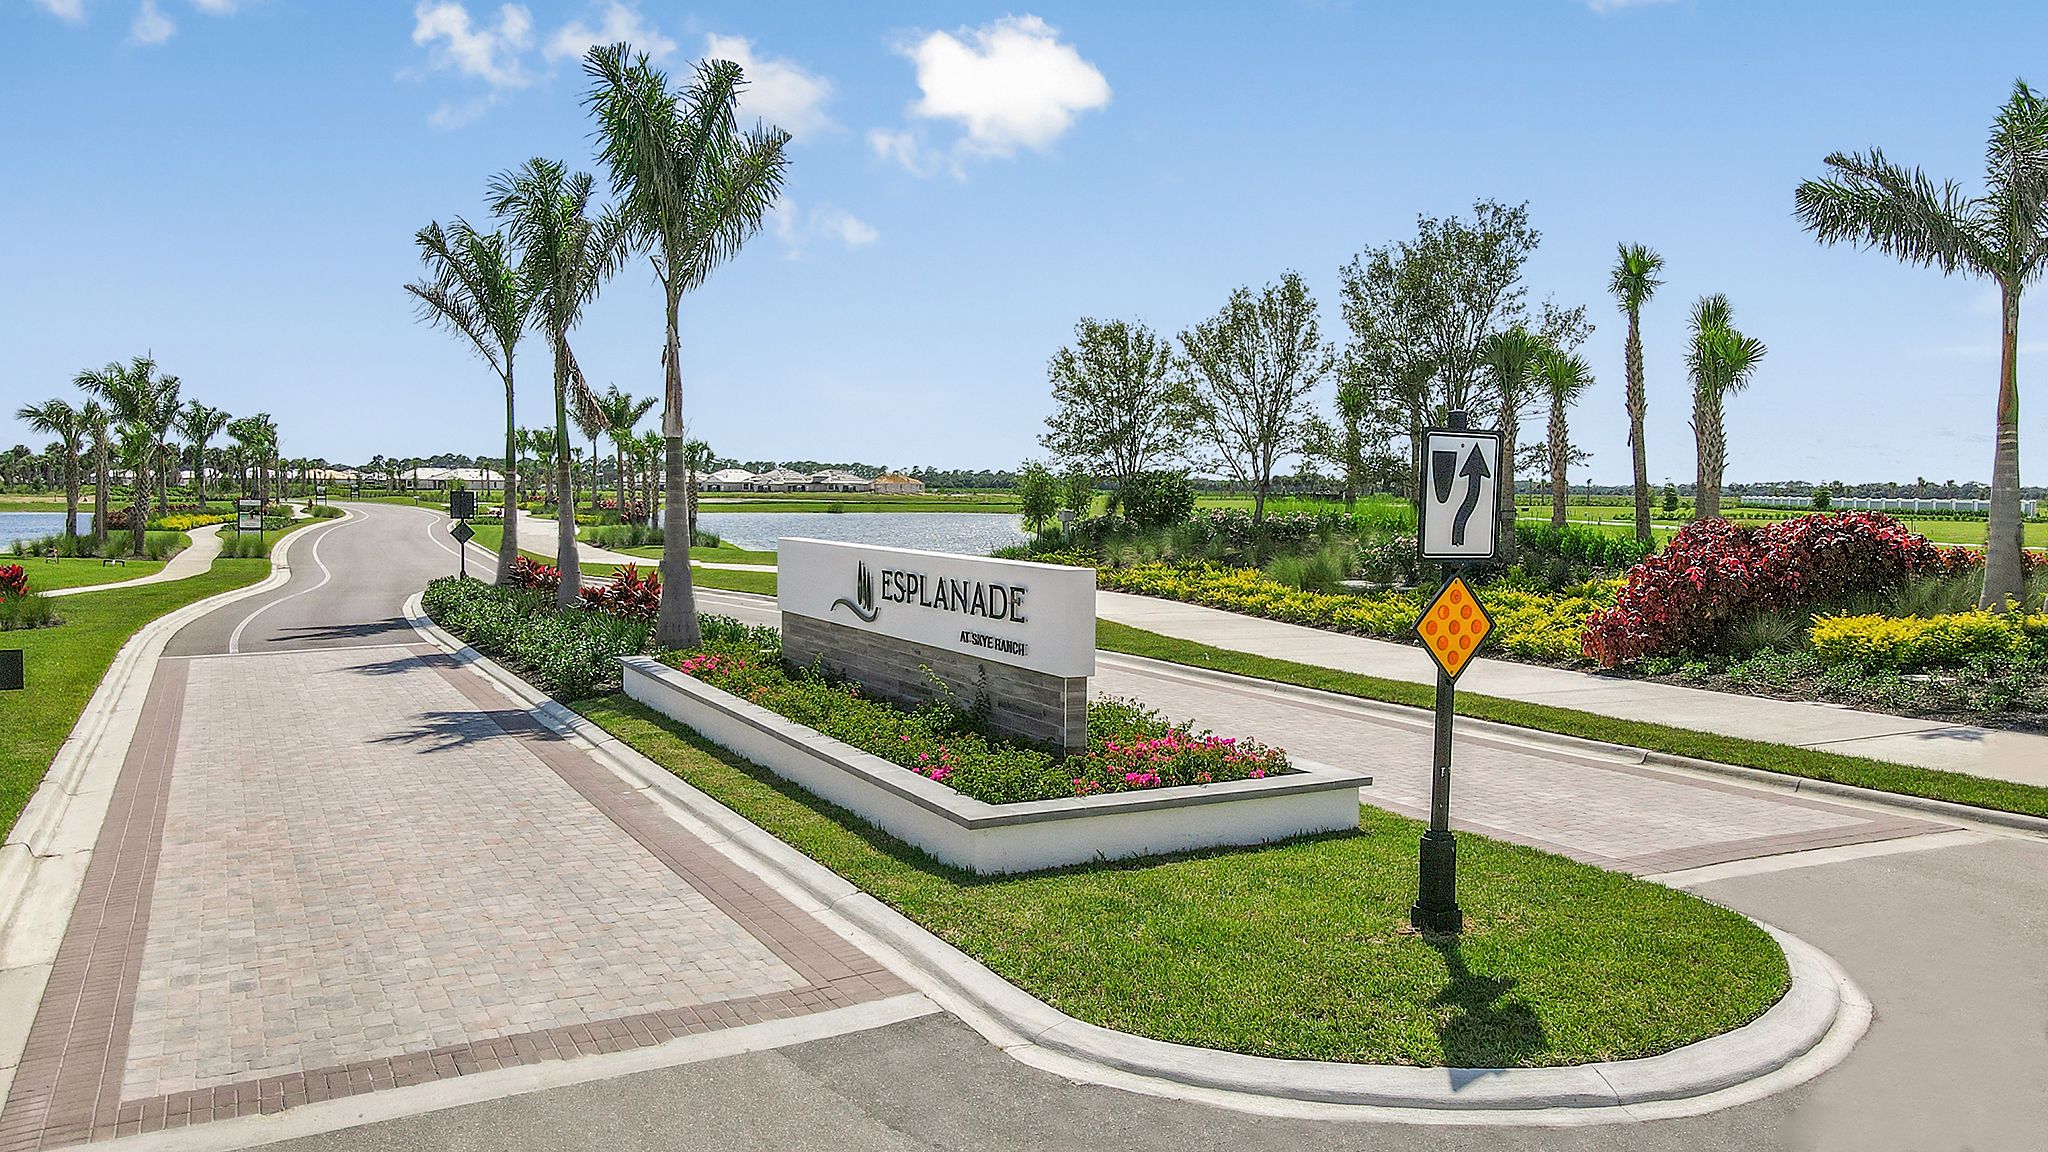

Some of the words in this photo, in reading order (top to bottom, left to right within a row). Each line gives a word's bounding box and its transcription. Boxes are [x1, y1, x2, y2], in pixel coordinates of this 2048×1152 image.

[881, 570, 1026, 623] ESPLANADE
[960, 630, 970, 643] AT
[971, 632, 993, 649] SKYE
[994, 638, 1025, 656] RANCH
